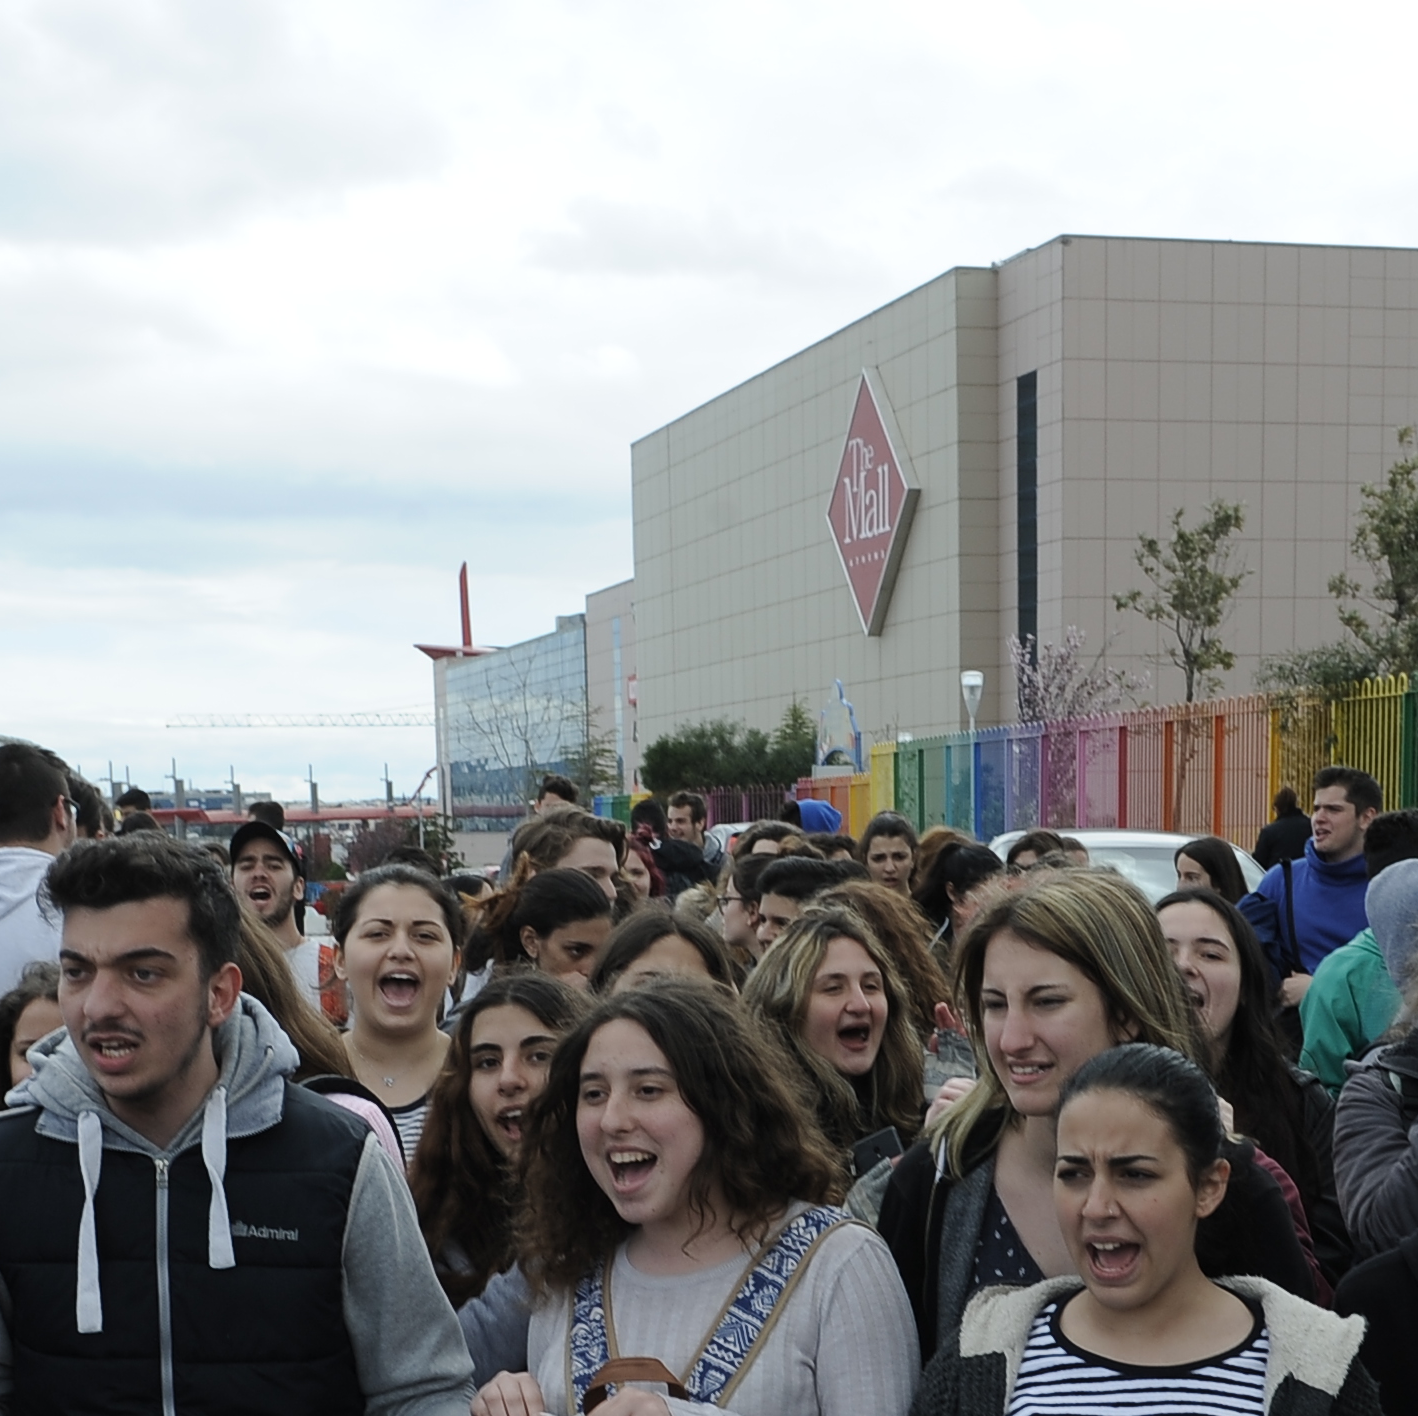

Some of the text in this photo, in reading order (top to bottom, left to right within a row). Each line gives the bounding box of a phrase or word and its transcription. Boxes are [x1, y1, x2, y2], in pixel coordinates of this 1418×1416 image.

[848, 437, 875, 492] The
[843, 463, 891, 544] Mall
[248, 1224, 299, 1241] Admiral
